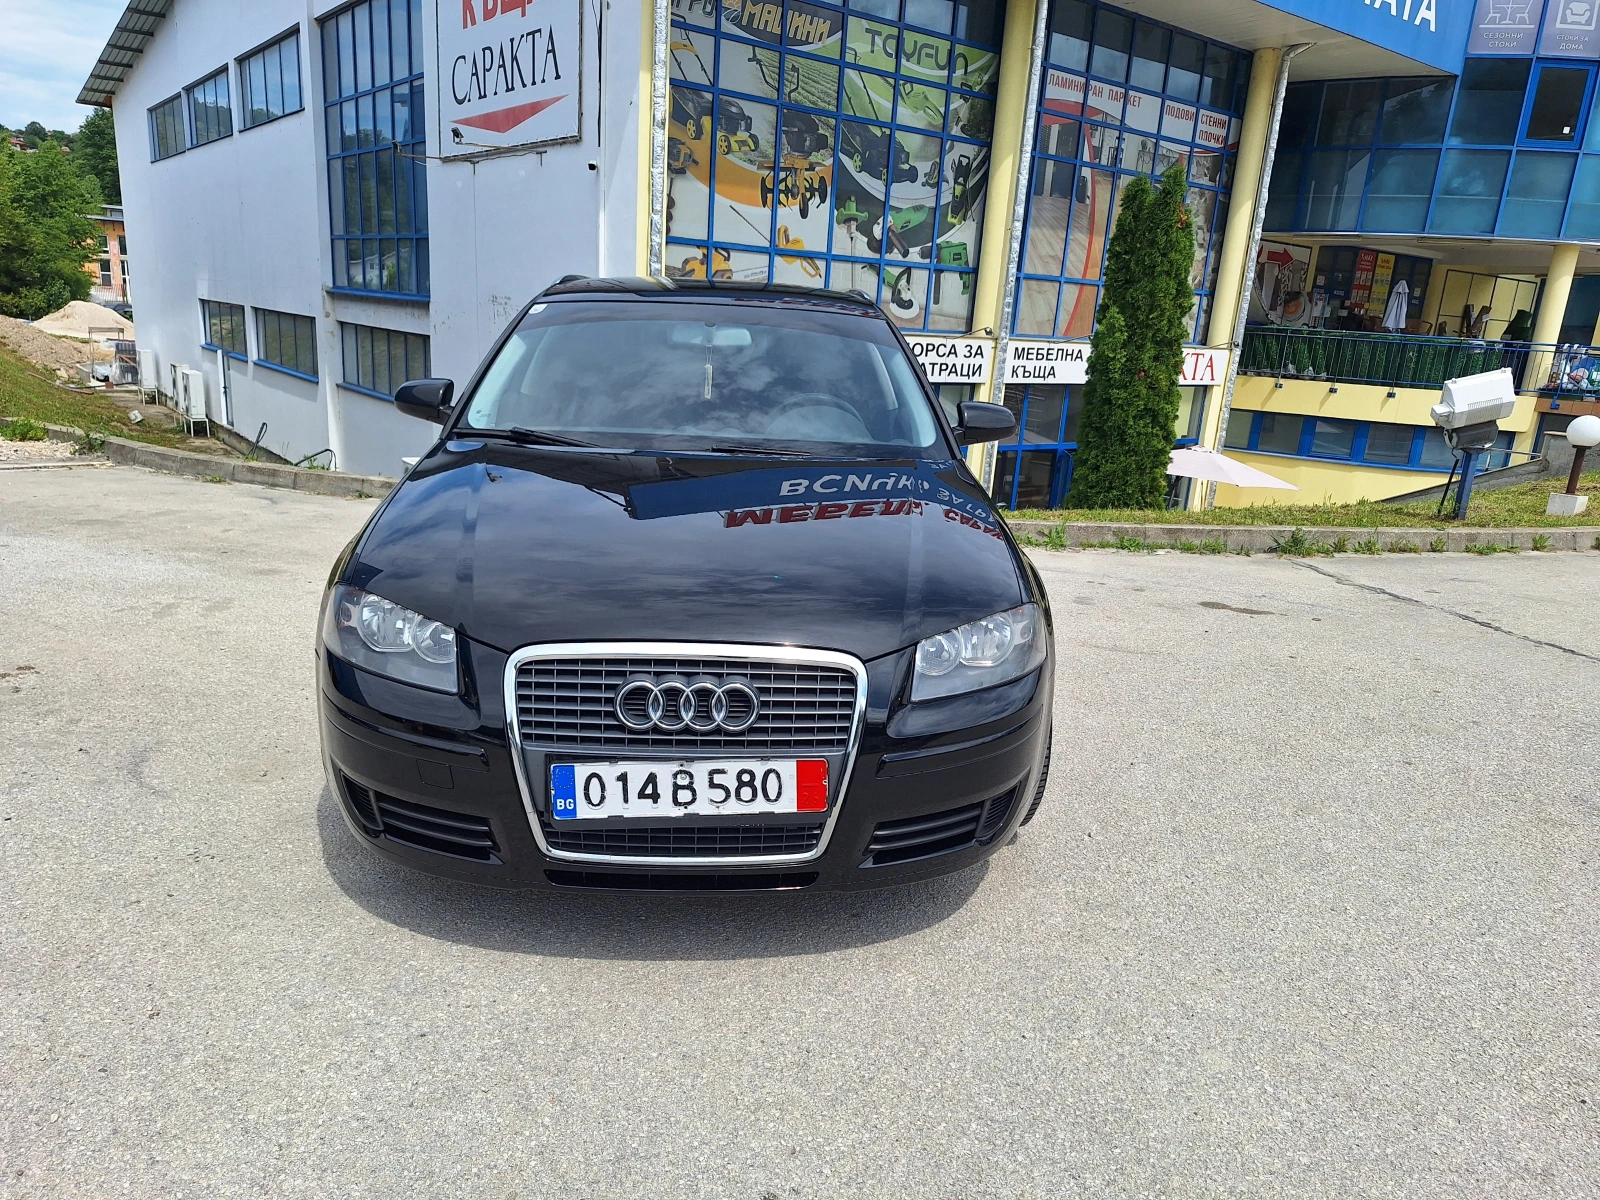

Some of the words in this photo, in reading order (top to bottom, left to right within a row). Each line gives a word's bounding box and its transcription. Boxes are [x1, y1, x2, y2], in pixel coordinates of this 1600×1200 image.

[741, 1, 831, 45] МАШИНИ
[1483, 32, 1524, 40] СЕЗОННИ
[1488, 40, 1517, 48] СТОКИ
[1559, 42, 1584, 51] ДОМА
[451, 23, 562, 106] САРАКТА
[1048, 73, 1104, 99] ЛАМИНИРАН
[1107, 88, 1142, 108] ПАРКЕТ
[1165, 104, 1195, 122] ПОДОВИ
[1200, 113, 1227, 131] СТЕННИ
[1198, 130, 1226, 146] ПЛОЧКИ
[907, 342, 958, 359] ОРСА
[963, 343, 985, 359] ЗА
[1013, 346, 1083, 362] МЕБЕЛНА
[920, 362, 983, 380] АТРАЦИ
[1011, 364, 1056, 380] КЪЩА
[556, 798, 575, 811] BG
